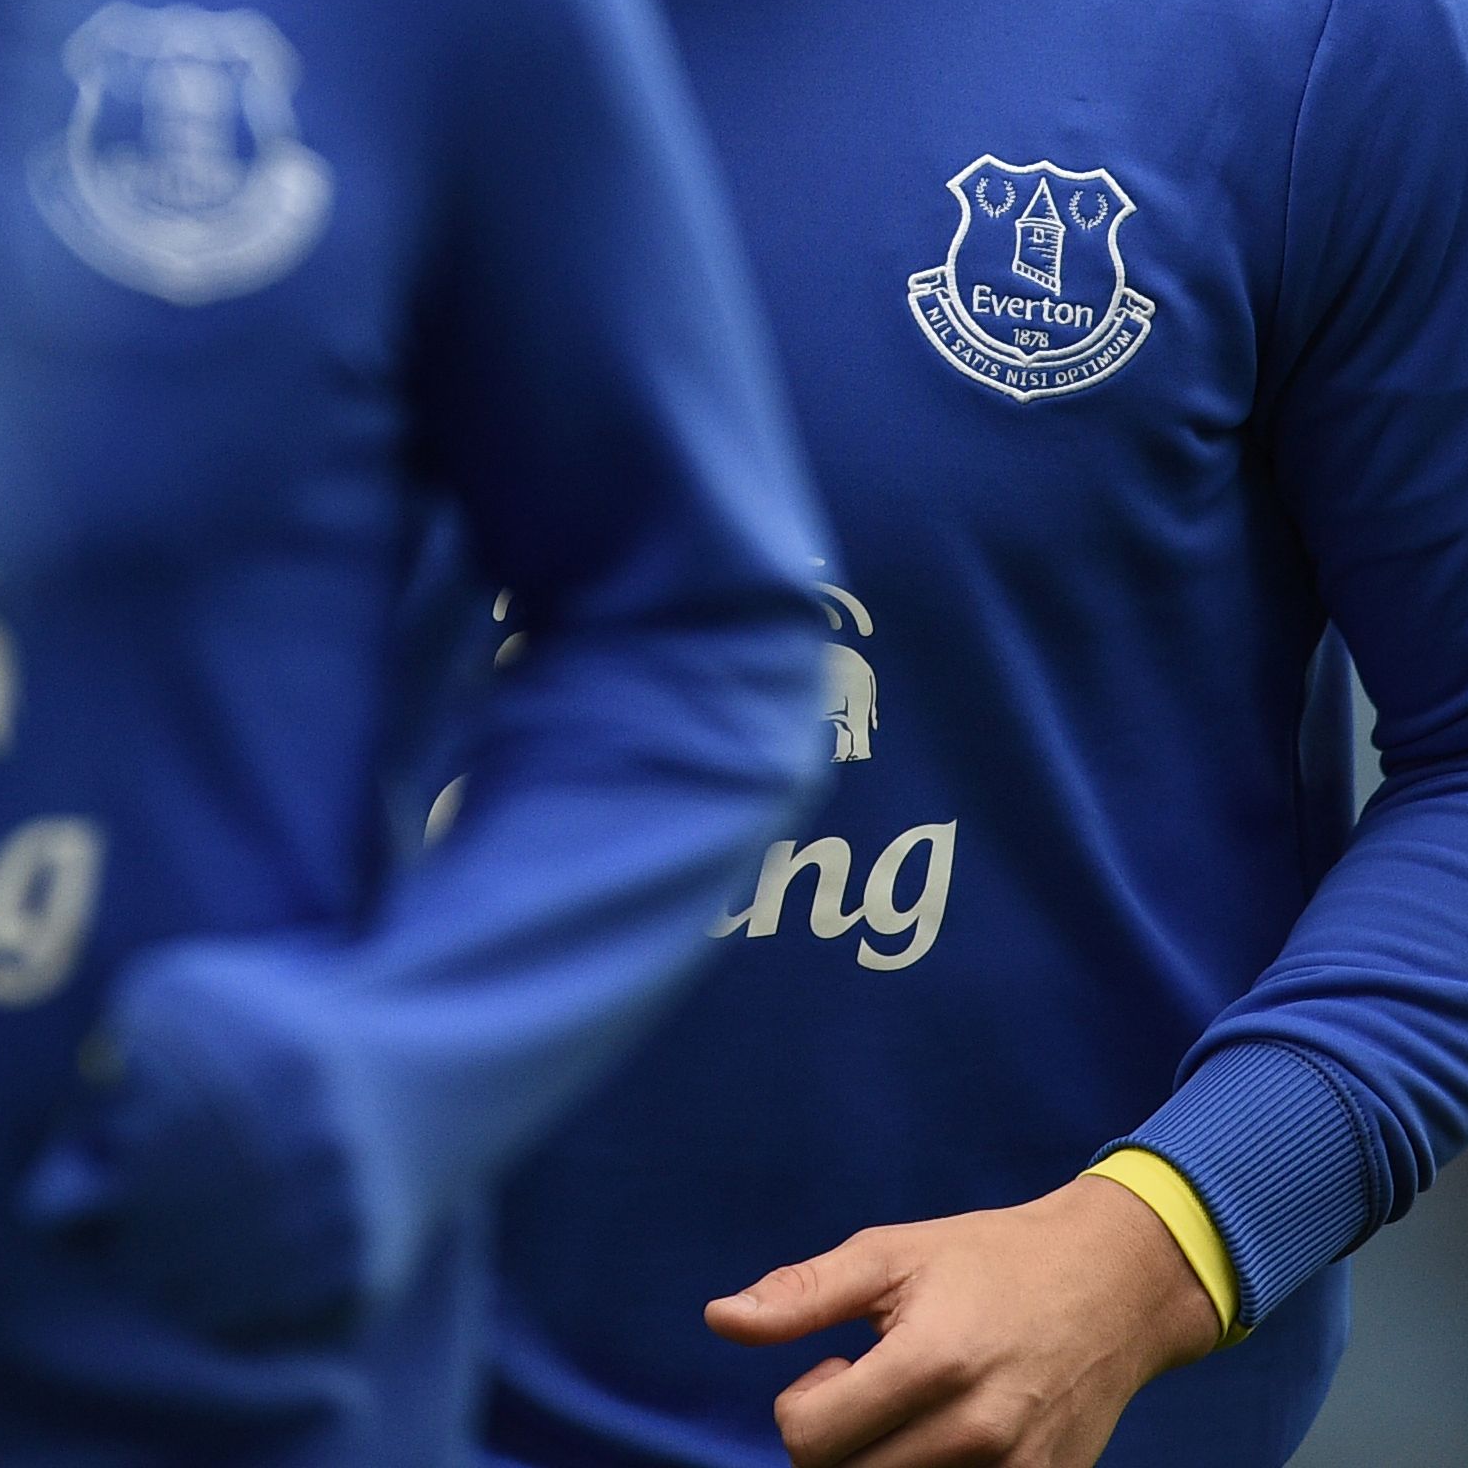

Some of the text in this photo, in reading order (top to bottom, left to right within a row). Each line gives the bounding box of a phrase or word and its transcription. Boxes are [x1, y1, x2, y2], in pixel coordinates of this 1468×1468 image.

[972, 284, 1094, 329] Everton
[925, 307, 1134, 387] NIL SATIS NISI OPTIMUM
[1012, 328, 1050, 349] 1878
[707, 818, 958, 972] ng
